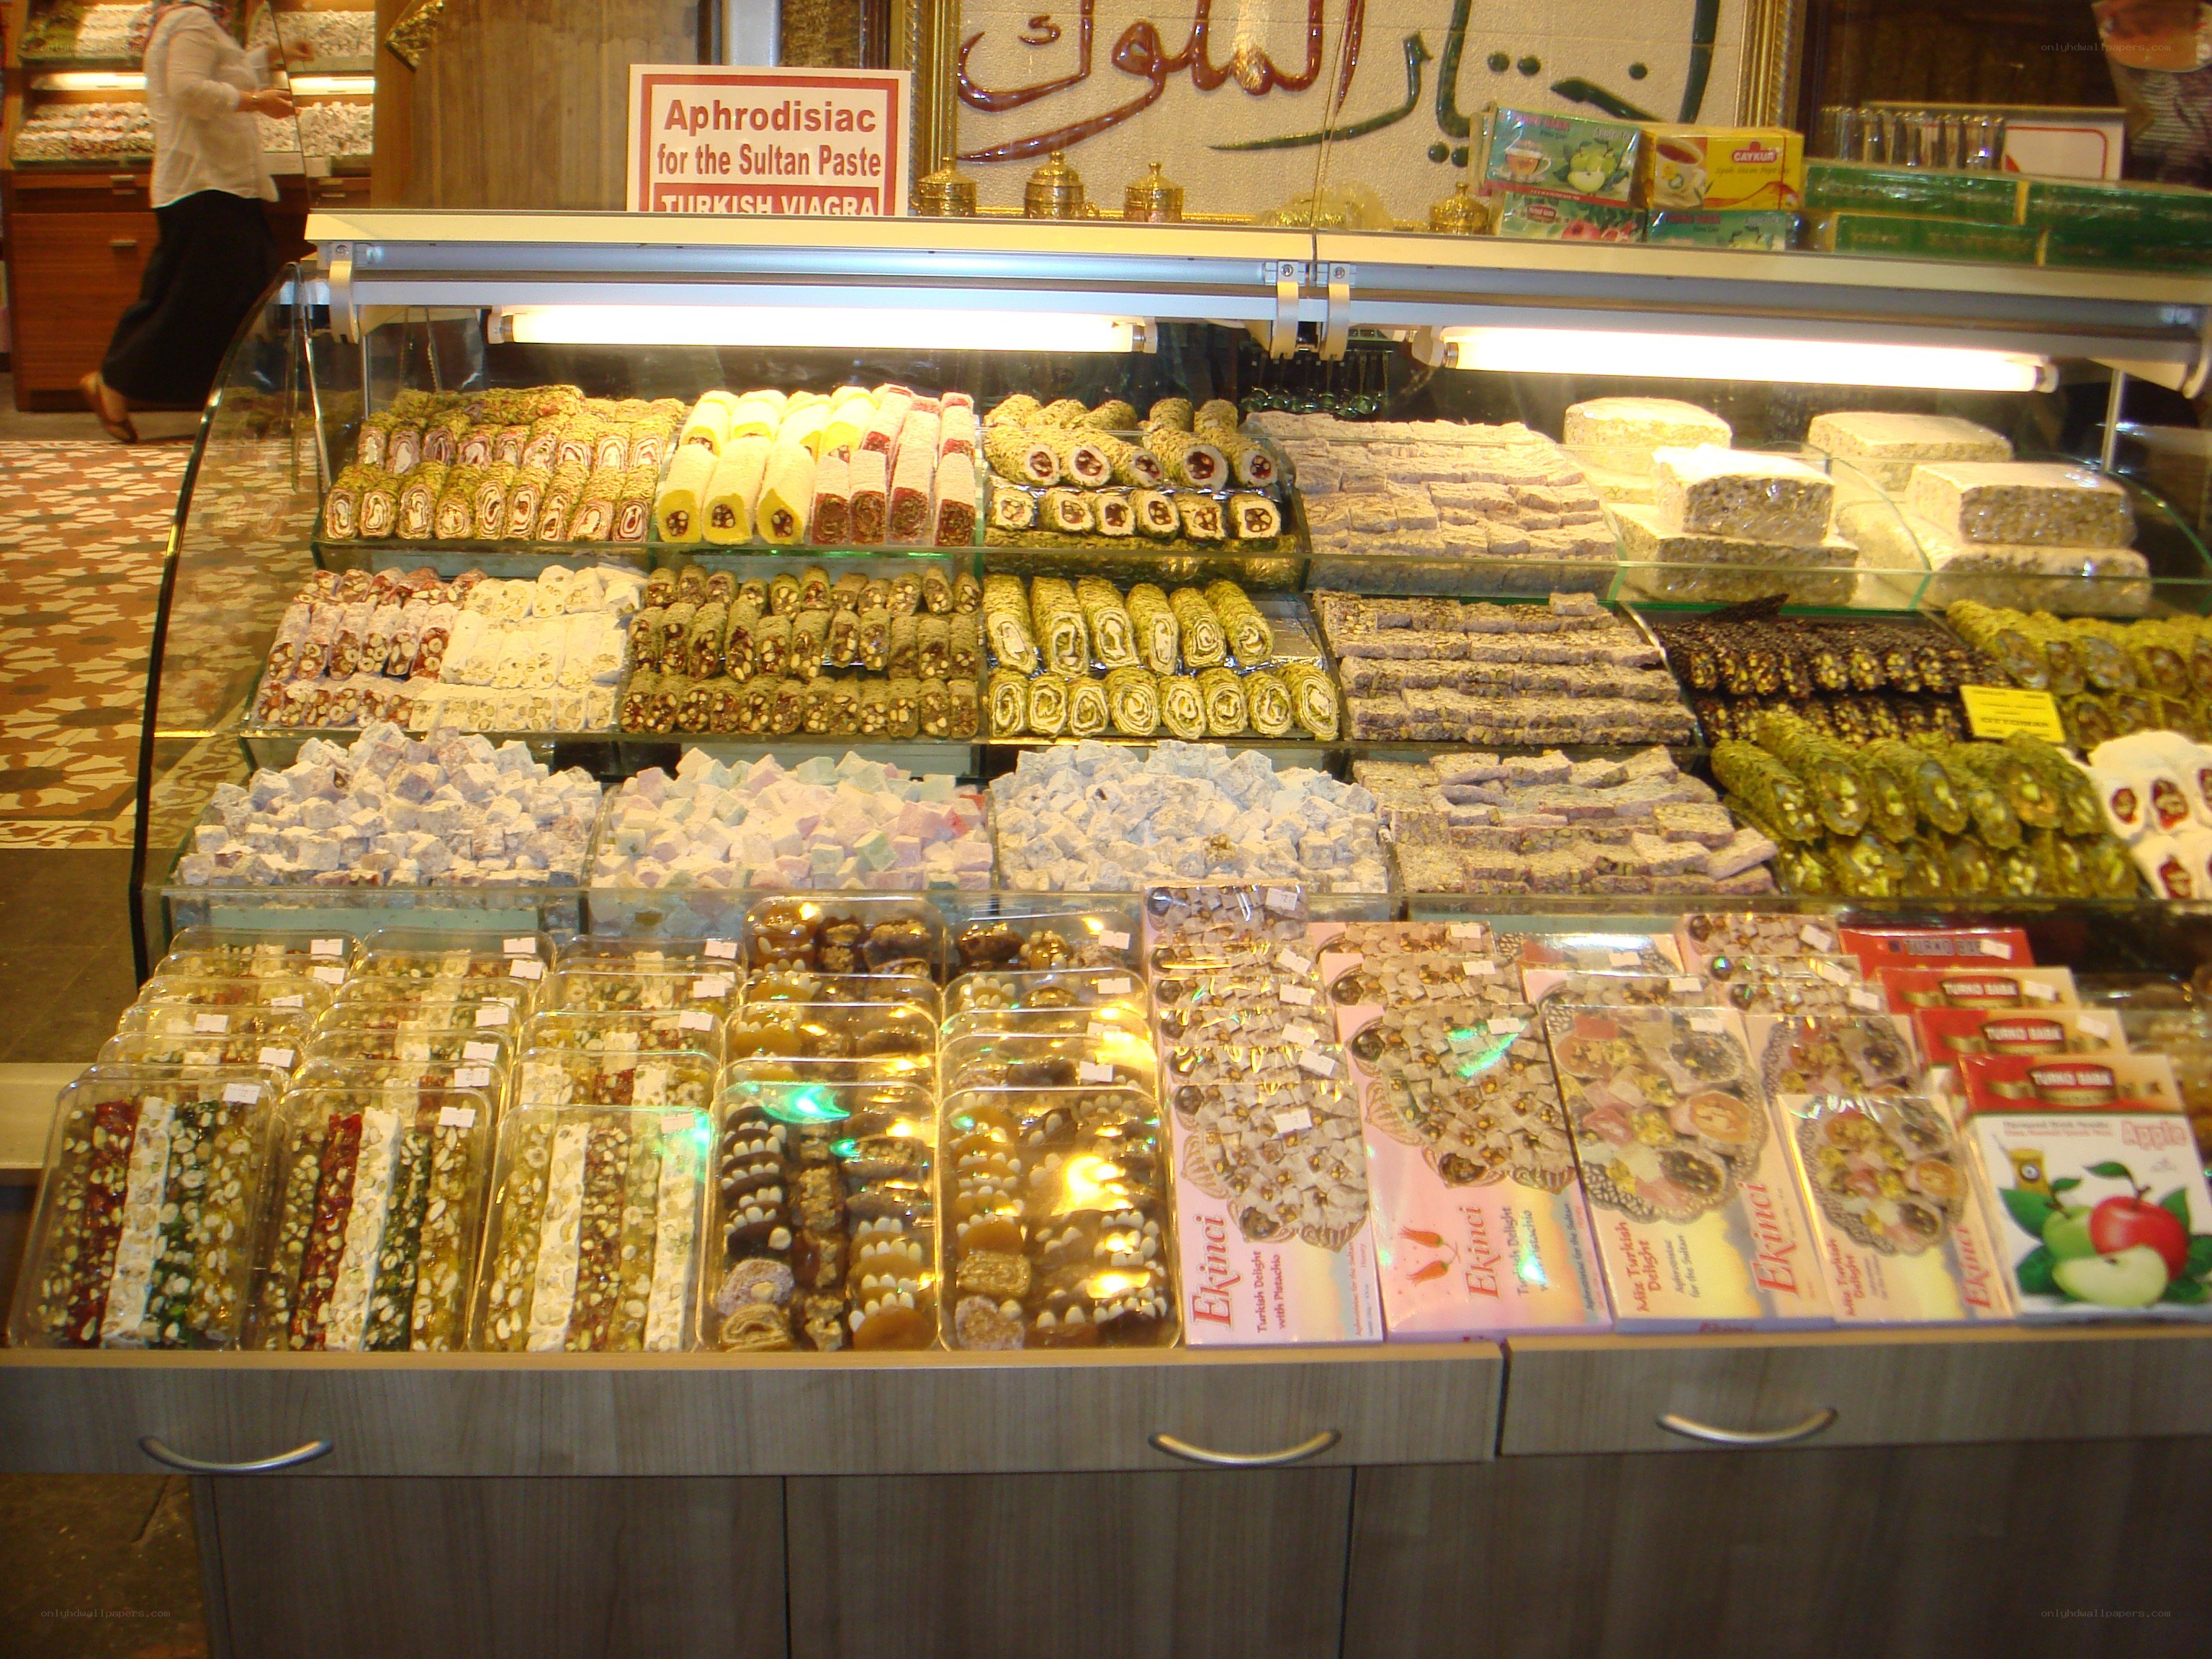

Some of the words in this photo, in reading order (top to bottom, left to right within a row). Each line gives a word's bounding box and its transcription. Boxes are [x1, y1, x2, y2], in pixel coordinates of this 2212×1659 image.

[664, 99, 876, 137] Aphrodisiac
[657, 143, 688, 175] for
[696, 144, 731, 175] the
[739, 145, 810, 176] Sultan
[819, 145, 881, 177] Paste
[661, 194, 772, 214] TURKISH
[781, 196, 874, 215] VIAGRA
[2121, 1119, 2187, 1151] Apple
[1501, 1206, 1520, 1246] Delight
[1737, 1181, 1800, 1298] Ekinci
[1459, 1207, 1501, 1299] Ekinci
[1614, 1221, 1641, 1277] Turkish
[1638, 1240, 1662, 1292] Delight
[1190, 1215, 1241, 1328] Ekinci
[1251, 1251, 1267, 1288] Delight
[1270, 1254, 1286, 1300] Pistachio
[1253, 1290, 1268, 1333] Turkish
[1274, 1304, 1287, 1329] with
[1633, 1282, 1650, 1313] Mix
